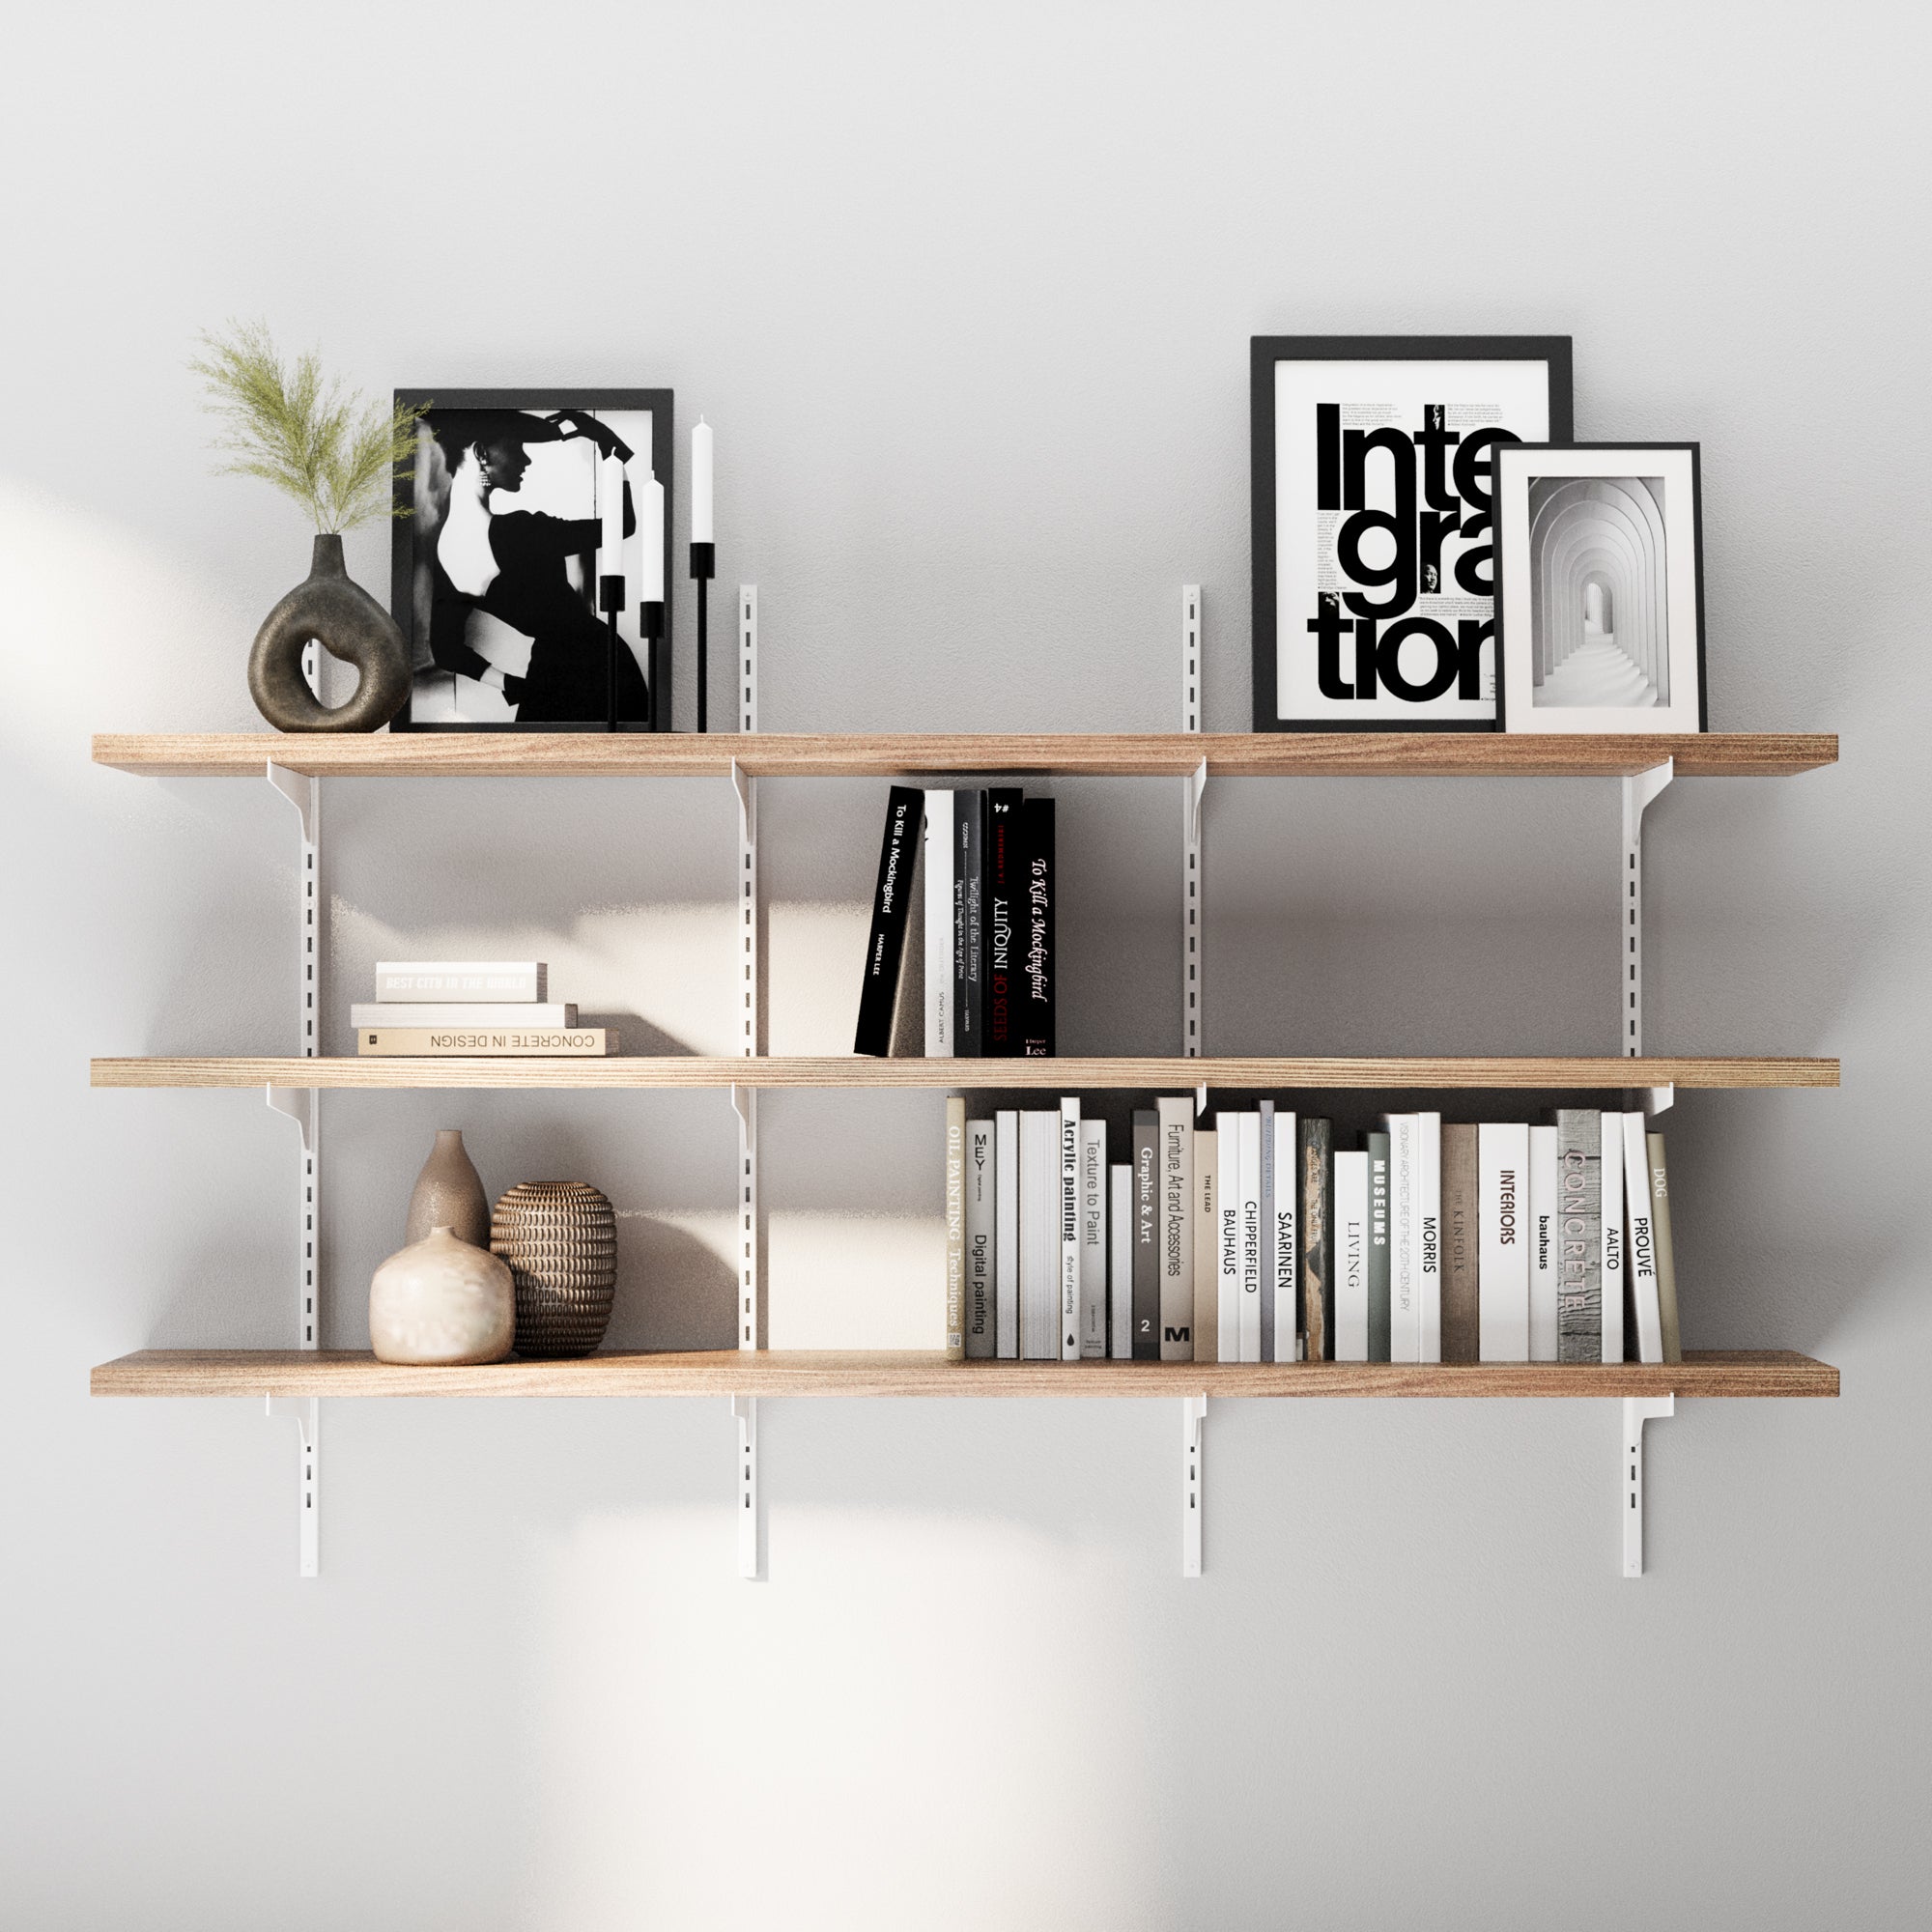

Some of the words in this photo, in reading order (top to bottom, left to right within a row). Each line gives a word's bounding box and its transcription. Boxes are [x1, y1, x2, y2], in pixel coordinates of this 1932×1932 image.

[1317, 403, 1523, 511] Inte
[893, 819, 904, 837] Kill
[895, 805, 906, 817] To
[880, 847, 899, 913] Mockingbird
[1032, 858, 1047, 875] To
[968, 876, 979, 914] Twilight
[1032, 879, 1047, 906] Kill
[954, 908, 964, 929] Thought
[970, 917, 979, 926] of
[970, 928, 979, 943] the
[994, 897, 1012, 970] INIQUITY
[875, 934, 884, 960] HARPER
[968, 947, 979, 981] Literary
[1025, 918, 1047, 1003] Mockingbird
[994, 974, 1007, 995] OF
[994, 998, 1007, 1041] SEEDS
[432, 1036, 487, 1047] DESIGN
[493, 1036, 506, 1047] IN
[511, 1035, 595, 1047] CONCRETE
[1026, 1045, 1046, 1056] Lee
[949, 1126, 960, 1155] OIL
[975, 1134, 987, 1171] MEY
[1063, 1120, 1076, 1172] Acrylic
[1167, 1124, 1183, 1173] Furniture,
[1400, 1122, 1409, 1159] VISIONARY
[1087, 1140, 1099, 1189] Texture
[1138, 1147, 1153, 1201] Graphic
[1168, 1175, 1183, 1190] Art
[1654, 1167, 1667, 1198] DOG
[948, 1159, 960, 1240] PAINTING
[1088, 1194, 1097, 1206] to
[1168, 1192, 1183, 1212] and
[1374, 1159, 1385, 1245] MUSEUMS
[1400, 1160, 1409, 1217] ARCHITECTURE
[1499, 1170, 1515, 1244] INTERIORS
[1063, 1177, 1076, 1242] painting
[1087, 1211, 1099, 1245] Paint
[1141, 1205, 1153, 1216] &
[1400, 1218, 1409, 1229] OF
[1140, 1219, 1153, 1243] Art
[1167, 1215, 1183, 1277] Accessories
[1223, 1209, 1236, 1275] BAUHAUS
[1244, 1201, 1258, 1293] CHIPPERFIELD
[1400, 1231, 1409, 1247] THE
[1424, 1217, 1436, 1273] MORRIS
[1454, 1211, 1464, 1273] KINFOLK
[1539, 1215, 1549, 1269] bauhaus
[1563, 1150, 1586, 1309] CONCRETE
[1634, 1217, 1656, 1277] PROUVÉ
[972, 1235, 987, 1276] Digital
[1278, 1212, 1293, 1288] SAARINEN
[1349, 1221, 1360, 1289] LIVING
[1400, 1248, 1409, 1269] 20TH
[1606, 1228, 1619, 1269] AALTO
[949, 1249, 960, 1326] Techniques
[1066, 1275, 1073, 1284] of
[1400, 1271, 1409, 1312] CENTURY
[972, 1282, 987, 1335] painting
[1141, 1320, 1150, 1332] 2
[1165, 1327, 1190, 1342] M
